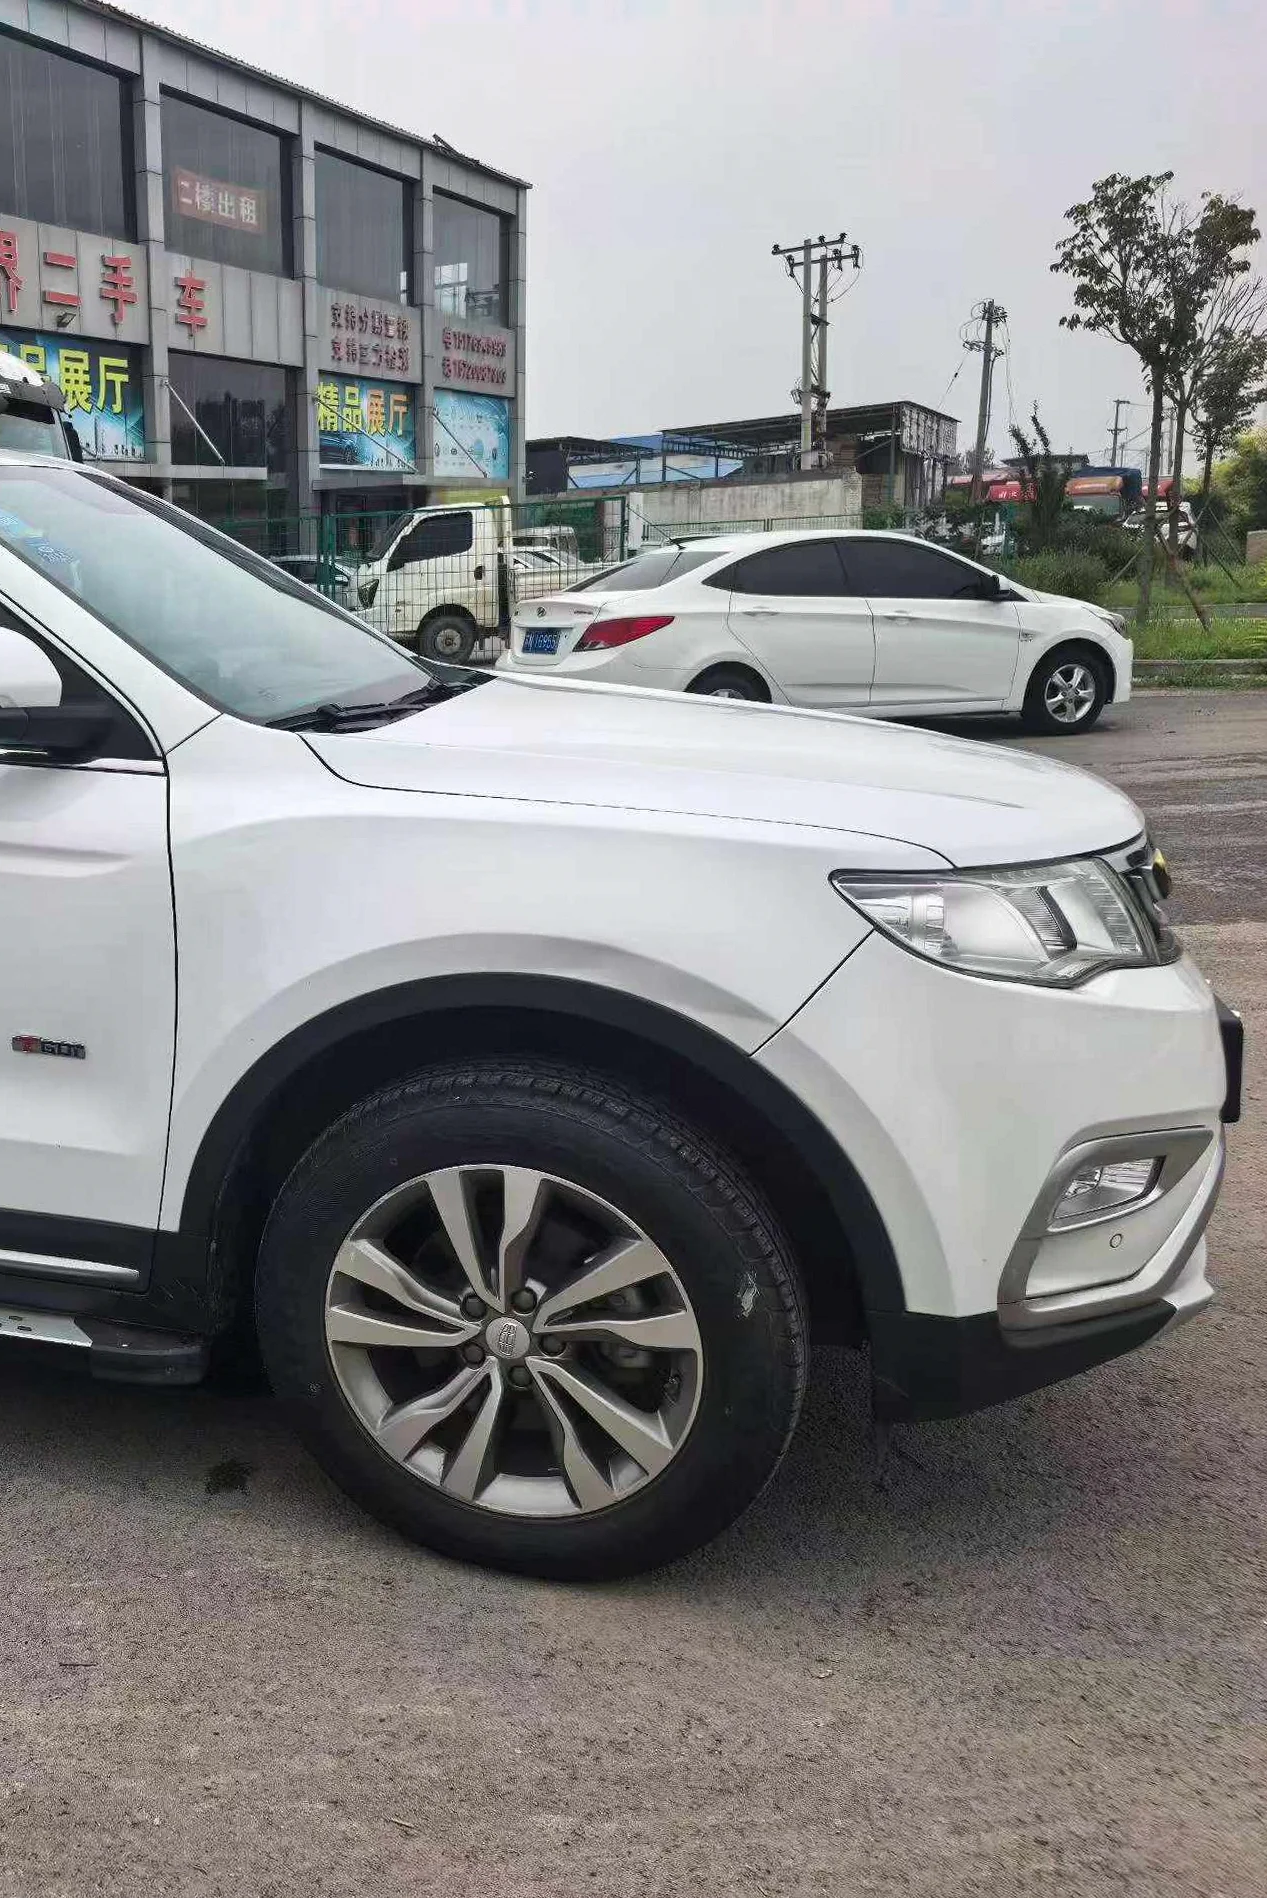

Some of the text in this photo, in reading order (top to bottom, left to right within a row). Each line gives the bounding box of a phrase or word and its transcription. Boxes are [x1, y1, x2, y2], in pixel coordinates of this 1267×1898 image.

[180, 181, 258, 225] 二楼出租
[317, 381, 409, 437] 精品展厅
